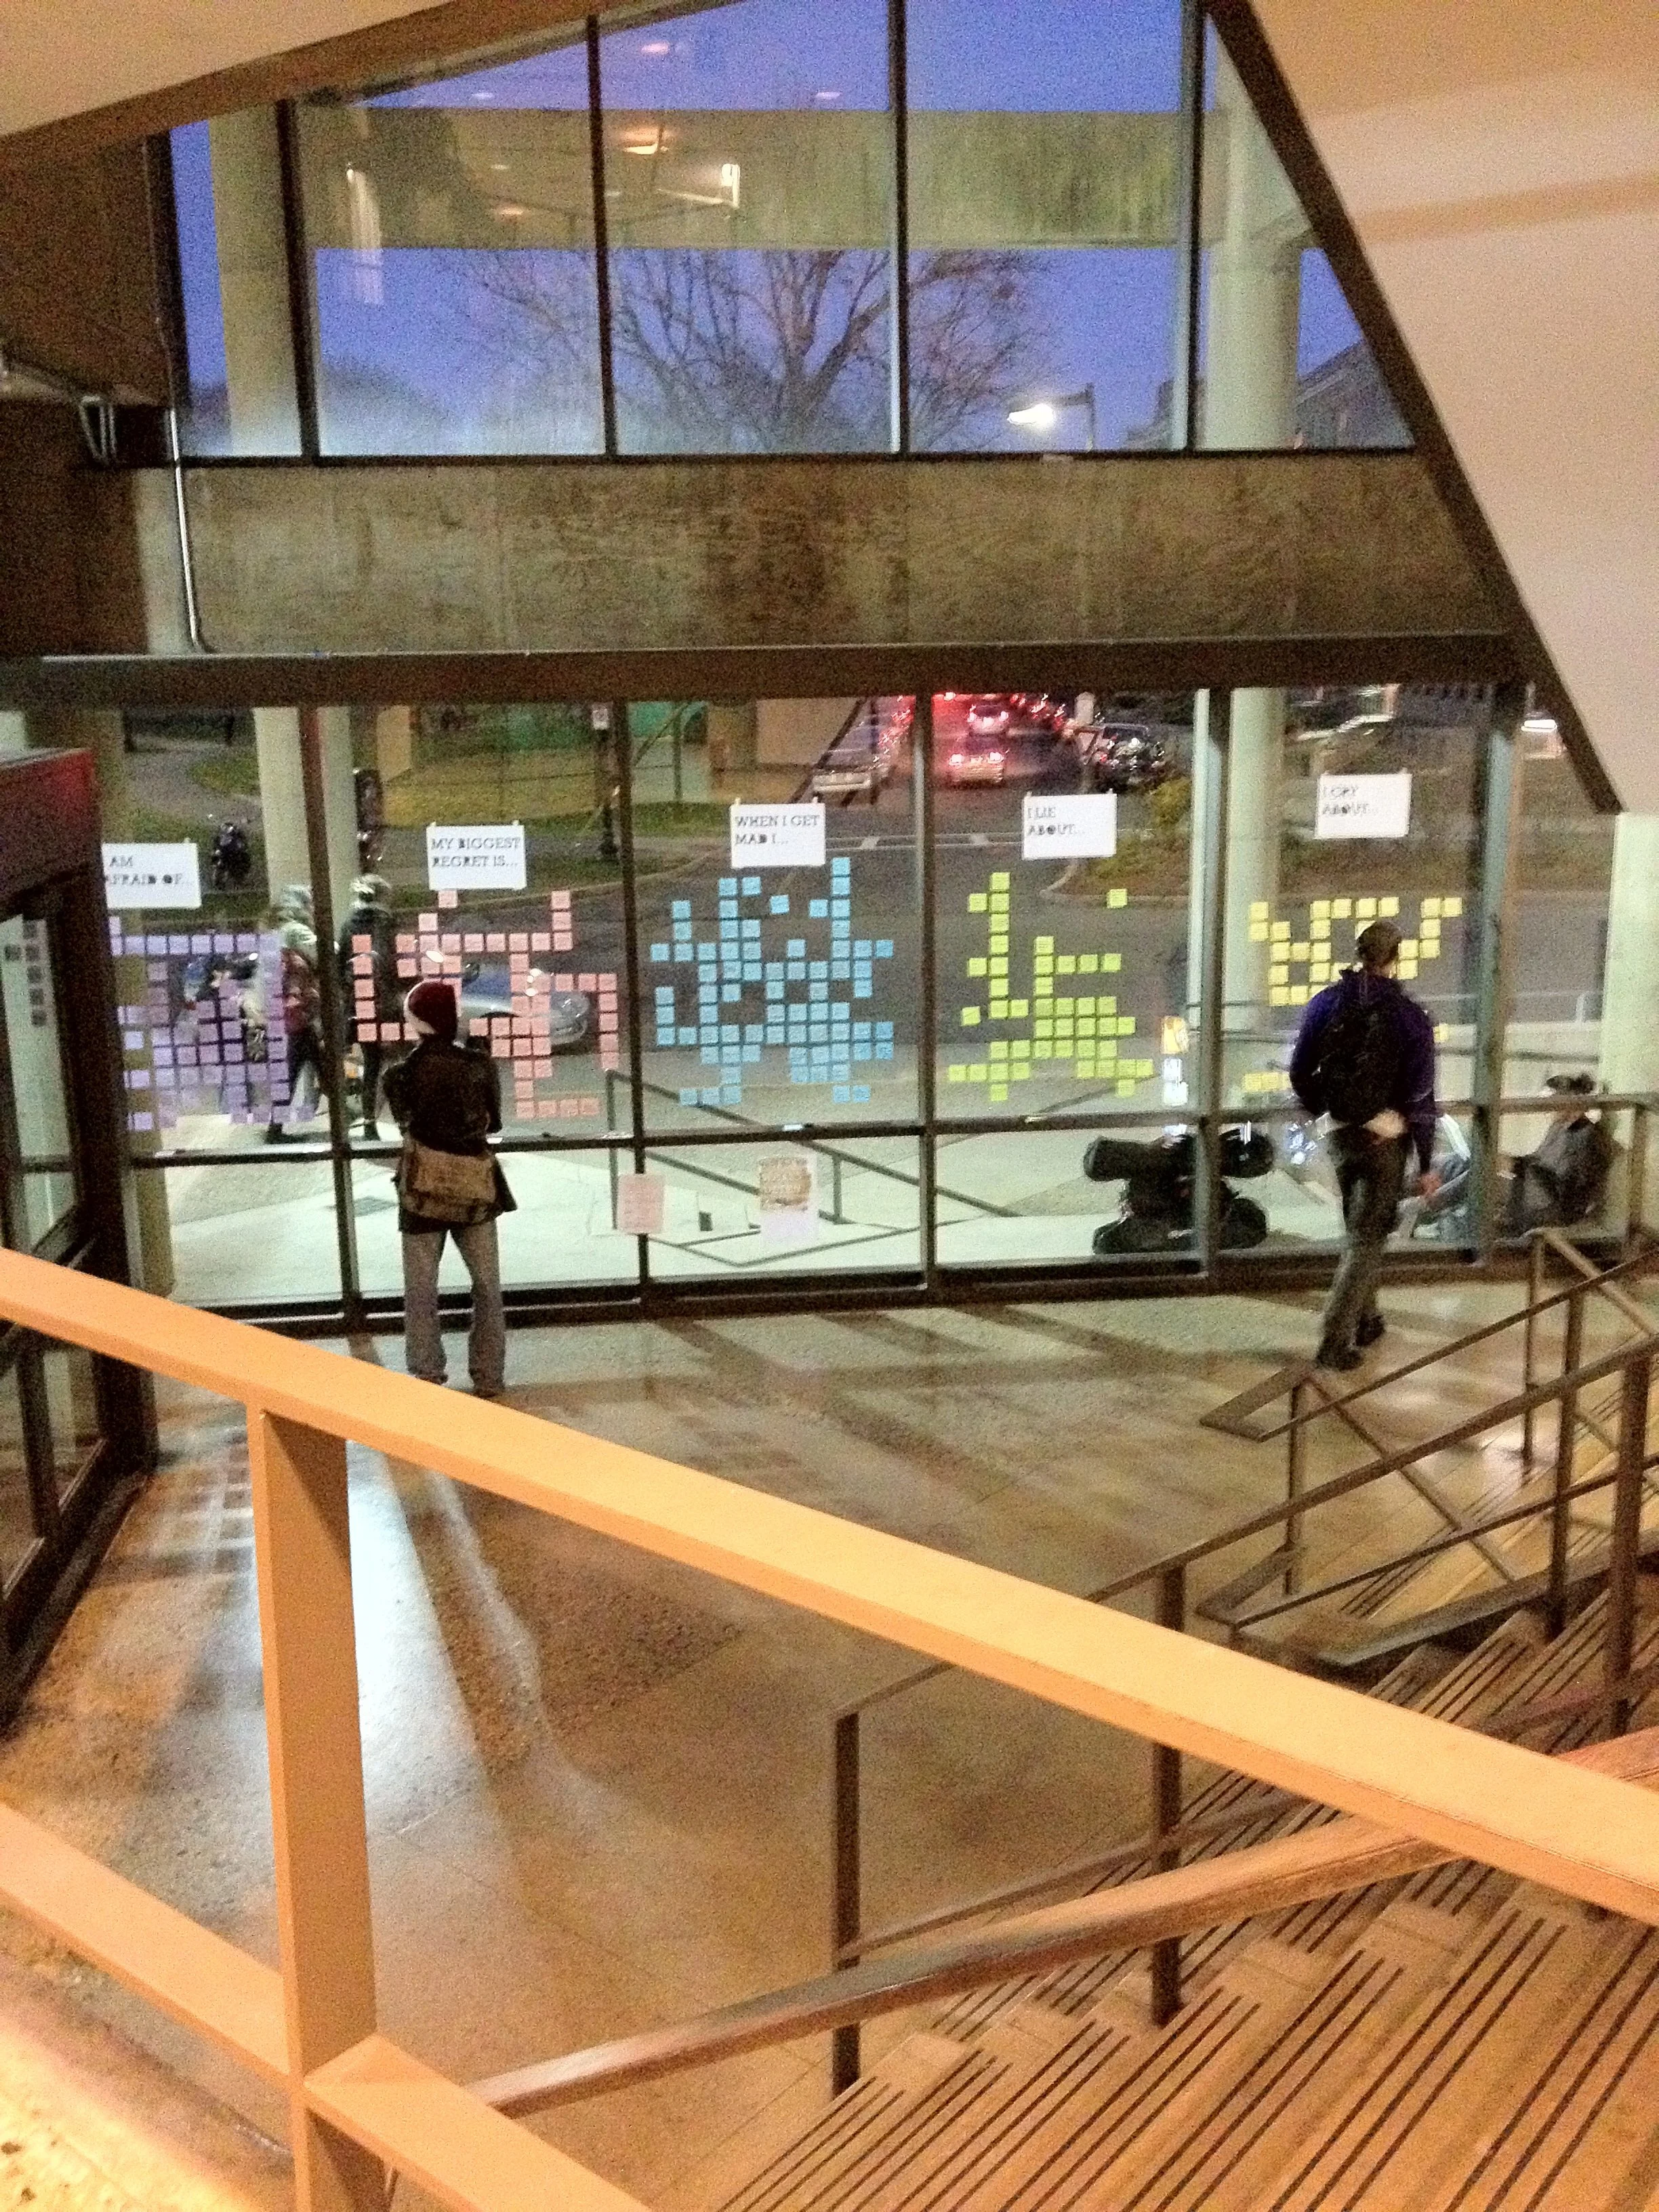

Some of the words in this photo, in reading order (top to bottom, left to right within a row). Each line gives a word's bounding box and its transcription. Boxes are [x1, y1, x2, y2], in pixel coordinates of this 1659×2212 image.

[735, 815, 779, 827] WHEN
[790, 815, 820, 826] GET
[432, 838, 455, 849] MY
[457, 838, 520, 849] BIGGEST
[735, 834, 767, 844] MAD
[432, 855, 485, 867] REGRET
